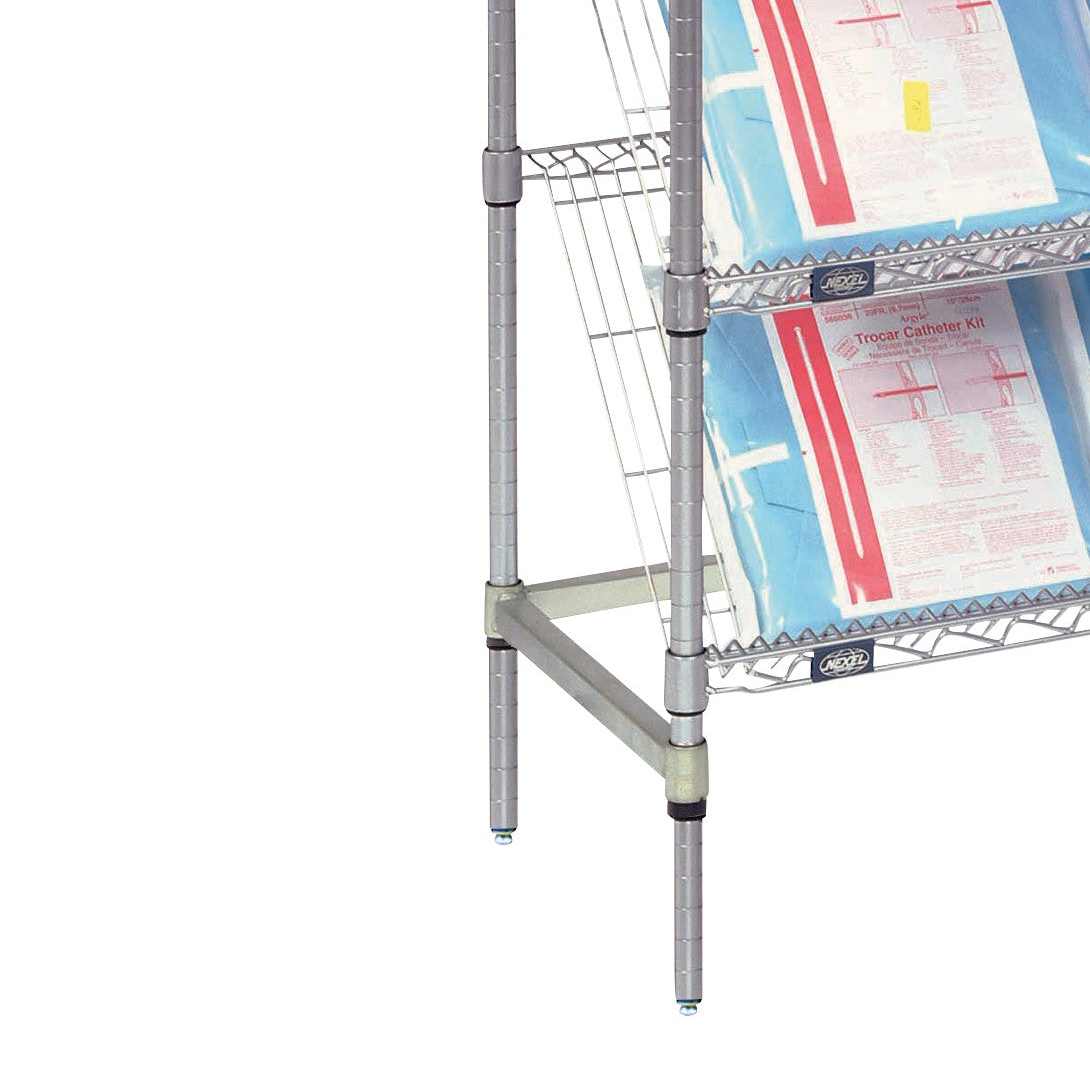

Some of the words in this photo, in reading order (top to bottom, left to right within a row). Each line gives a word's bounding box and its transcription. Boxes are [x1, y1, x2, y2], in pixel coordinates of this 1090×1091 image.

[823, 274, 867, 288] NEXEL
[900, 312, 927, 324] Argyle
[853, 330, 900, 345] Trocar
[903, 321, 962, 338] Catheter
[965, 316, 986, 330] Kit
[825, 654, 867, 671] NEXEL
